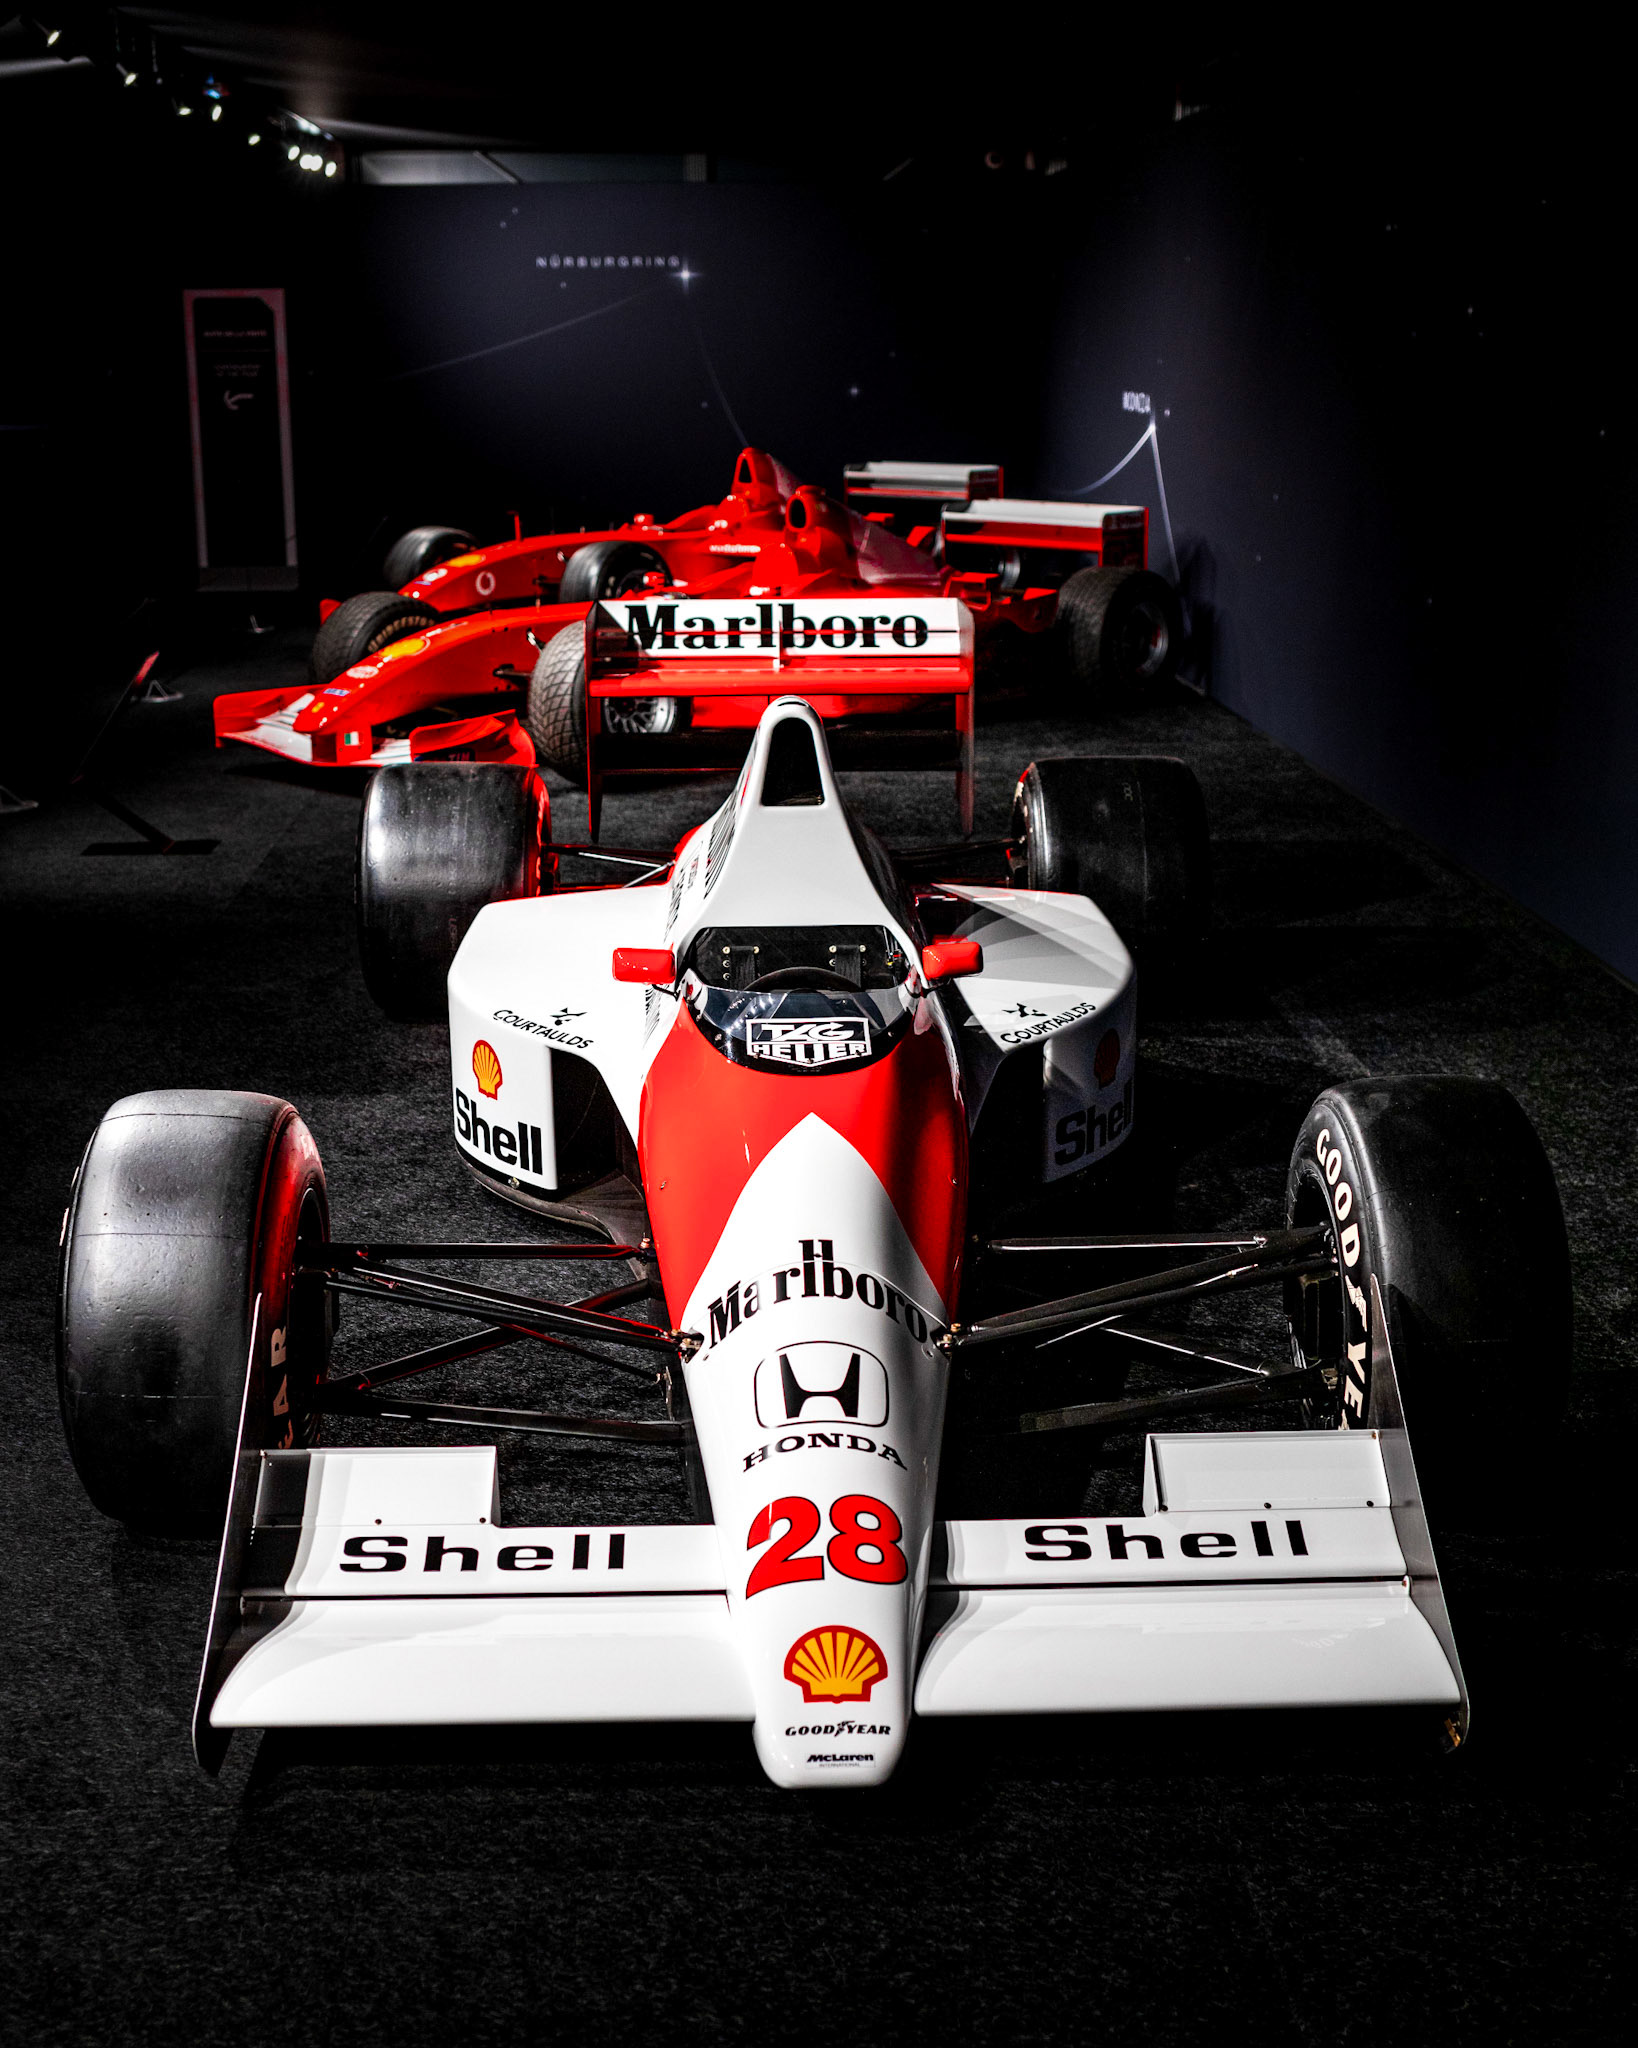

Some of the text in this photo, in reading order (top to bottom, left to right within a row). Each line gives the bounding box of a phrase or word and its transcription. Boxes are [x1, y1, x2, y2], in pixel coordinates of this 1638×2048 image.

[535, 254, 681, 269] NÜRBURGRING
[624, 603, 928, 650] Marlboro
[493, 1009, 594, 1049] COURTAULDS
[761, 1022, 854, 1042] TAG
[1000, 1002, 1096, 1044] COURTAULDS
[455, 1087, 543, 1175] Shell
[707, 1239, 928, 1350] Marlboro
[742, 1432, 908, 1473] HONDA
[339, 1533, 626, 1573] Shell
[745, 1493, 909, 1600] 28
[1024, 1519, 1309, 1561] Shell
[785, 1724, 891, 1736] GOODYEAR
[806, 1754, 874, 1763] McLaren
